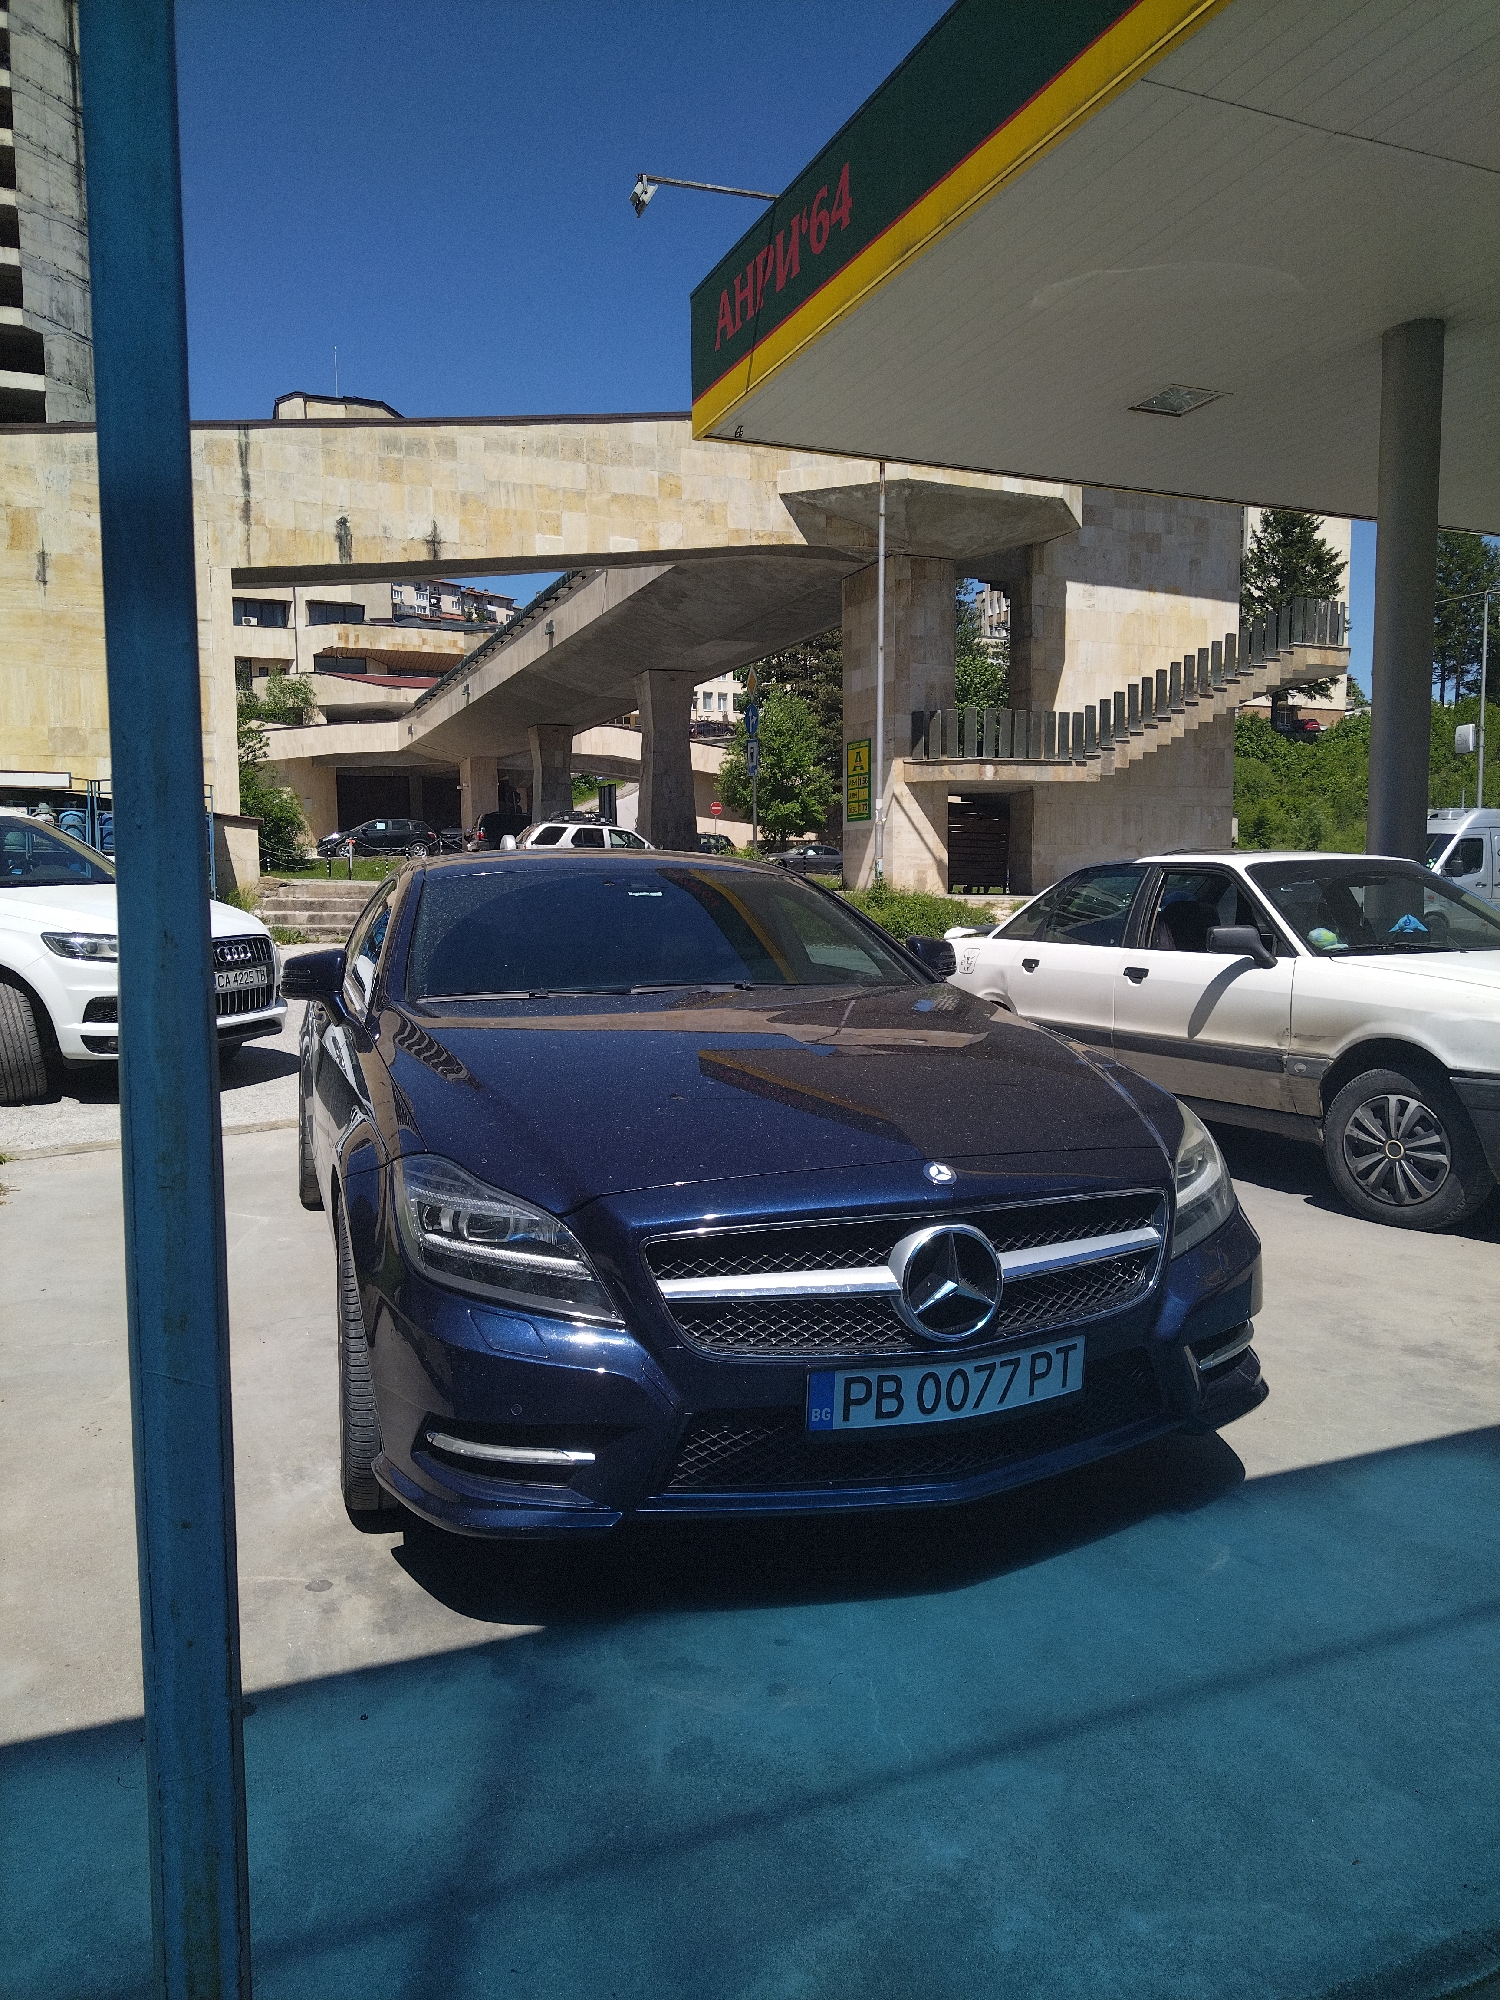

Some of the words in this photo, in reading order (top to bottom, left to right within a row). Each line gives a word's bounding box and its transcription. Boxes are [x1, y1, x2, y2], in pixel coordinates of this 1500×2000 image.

[217, 974, 231, 987] CA
[233, 970, 254, 985] 4225
[842, 1374, 905, 1422] PB
[916, 1357, 1021, 1415] 0077
[1028, 1343, 1078, 1397] PT
[811, 1408, 831, 1422] BG
